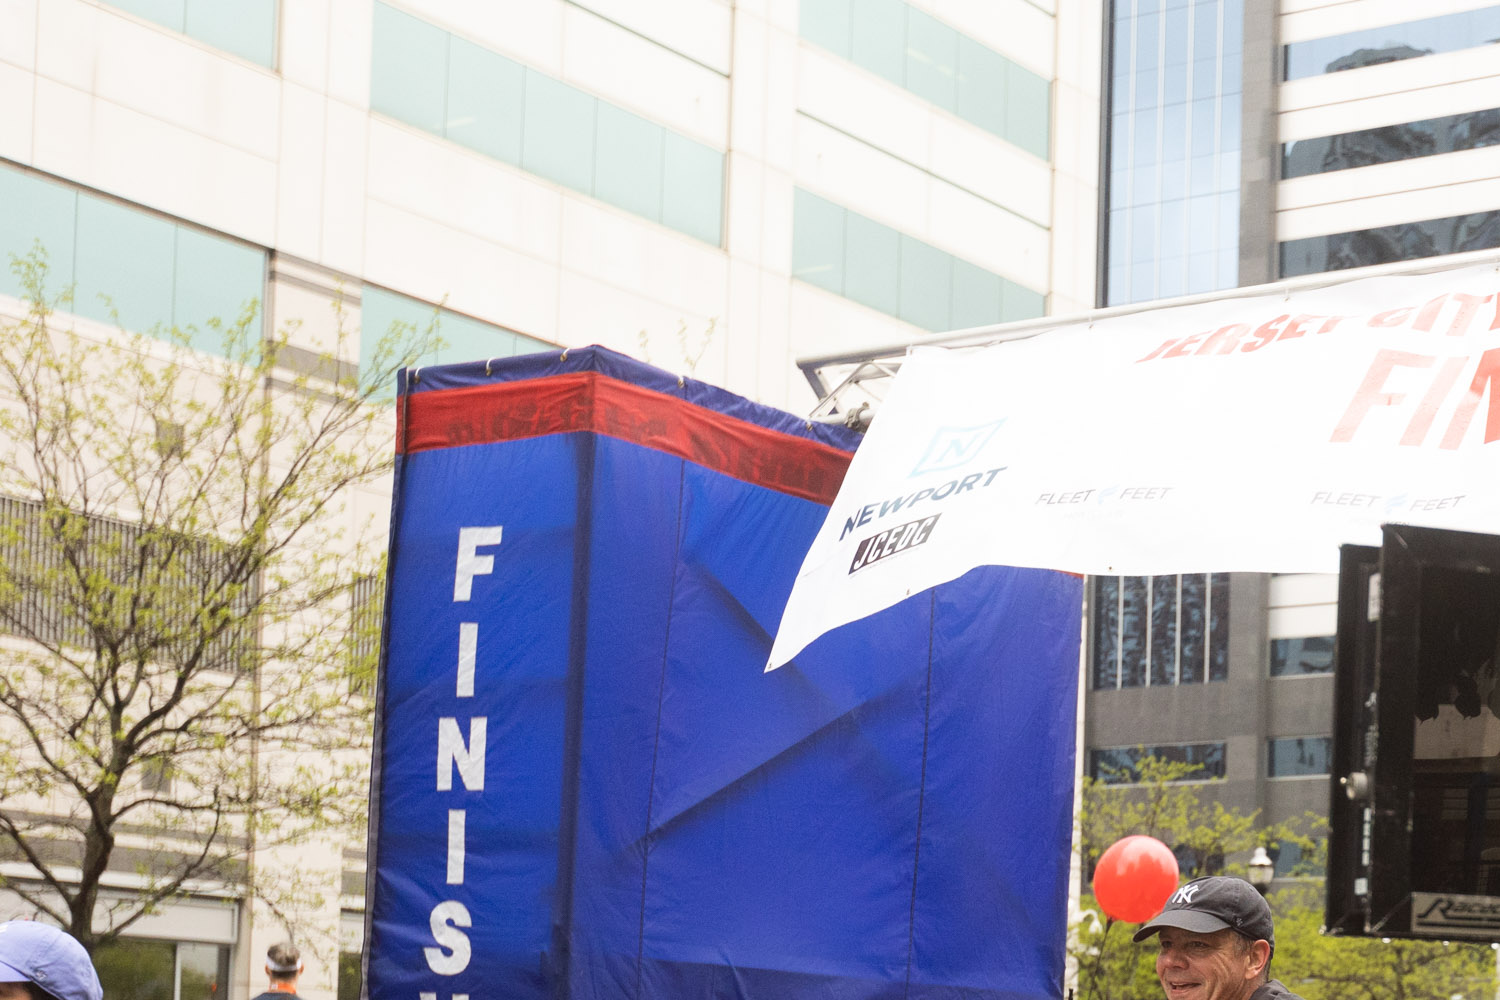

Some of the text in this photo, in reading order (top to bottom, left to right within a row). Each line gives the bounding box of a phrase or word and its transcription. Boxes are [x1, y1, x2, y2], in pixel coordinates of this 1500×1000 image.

[838, 465, 1008, 542] NEWPORT
[1034, 486, 1175, 505] FLEET FEET
[1310, 490, 1468, 512] FLEET FEET
[852, 516, 937, 571] JCEDC
